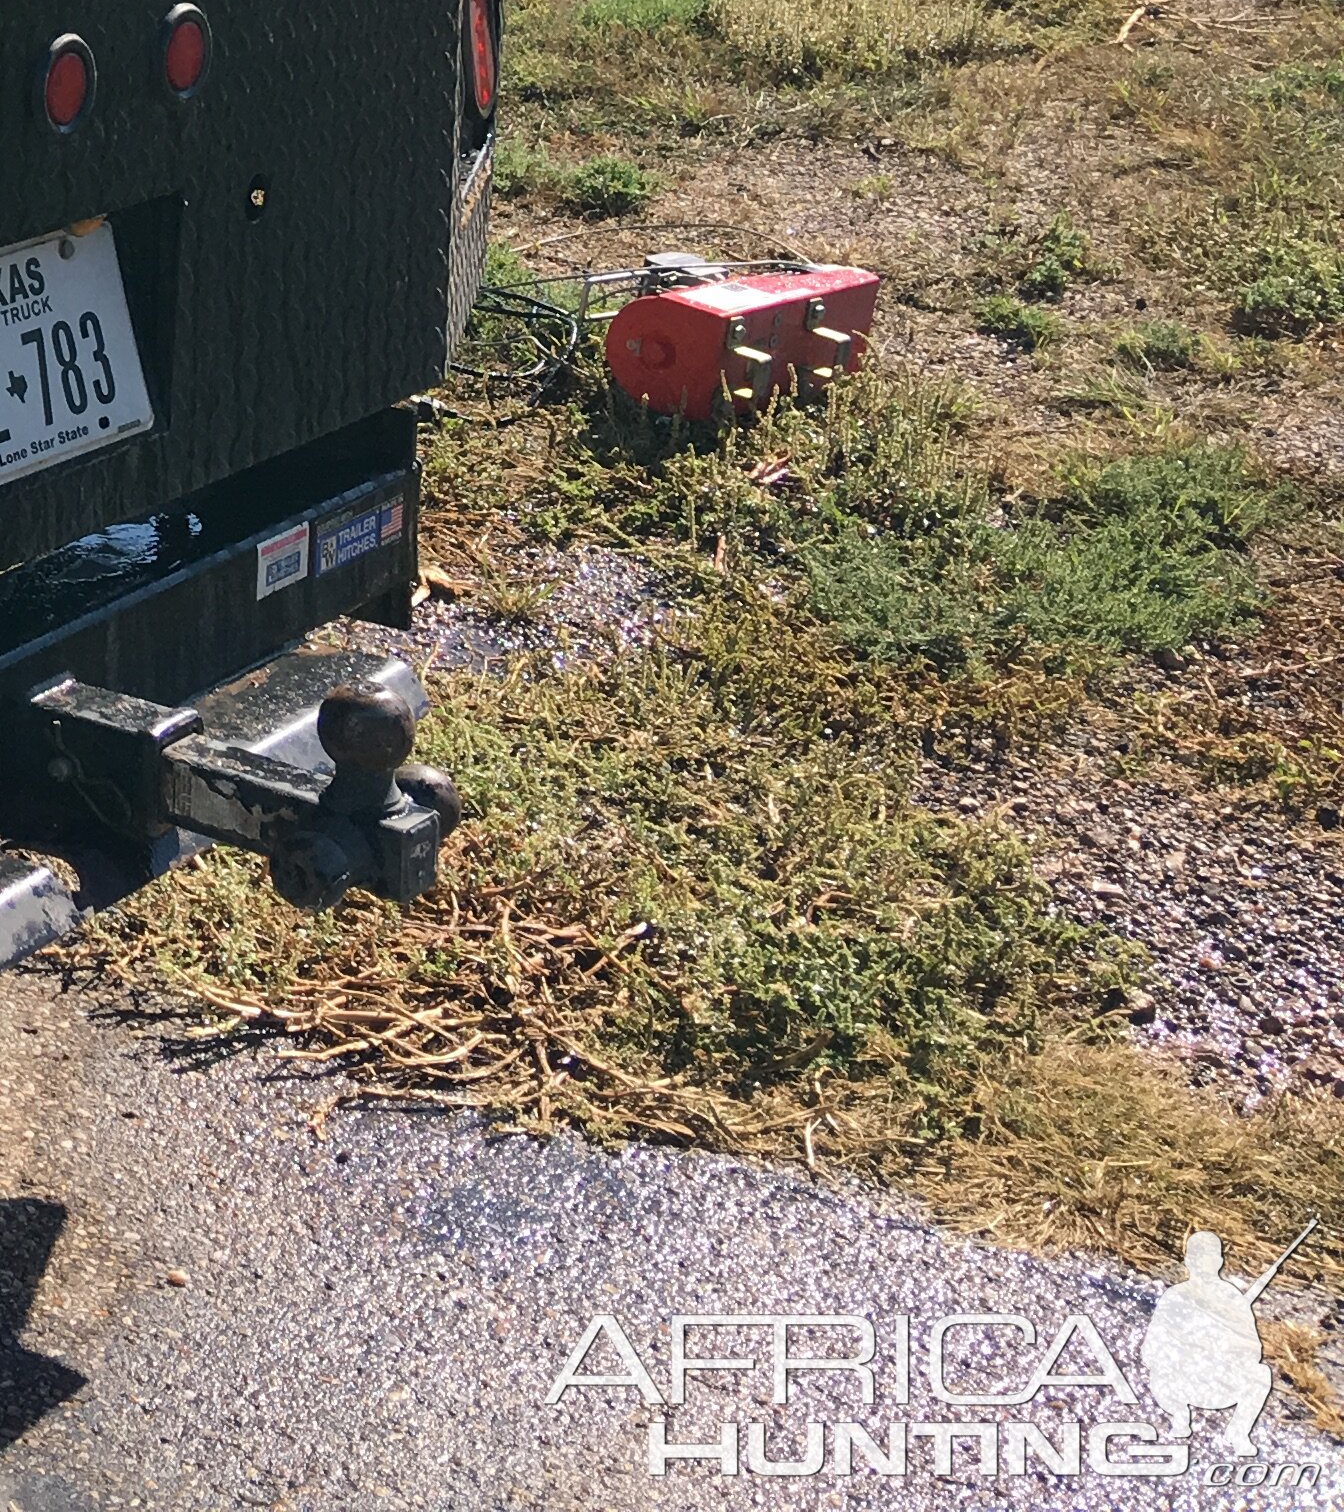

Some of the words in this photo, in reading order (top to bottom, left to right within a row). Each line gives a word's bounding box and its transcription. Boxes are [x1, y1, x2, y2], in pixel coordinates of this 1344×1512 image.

[3, 295, 53, 328] TRUCK
[0, 446, 28, 468] Lone
[30, 434, 56, 455] Star
[57, 424, 89, 445] State
[338, 515, 376, 545] TRAILER
